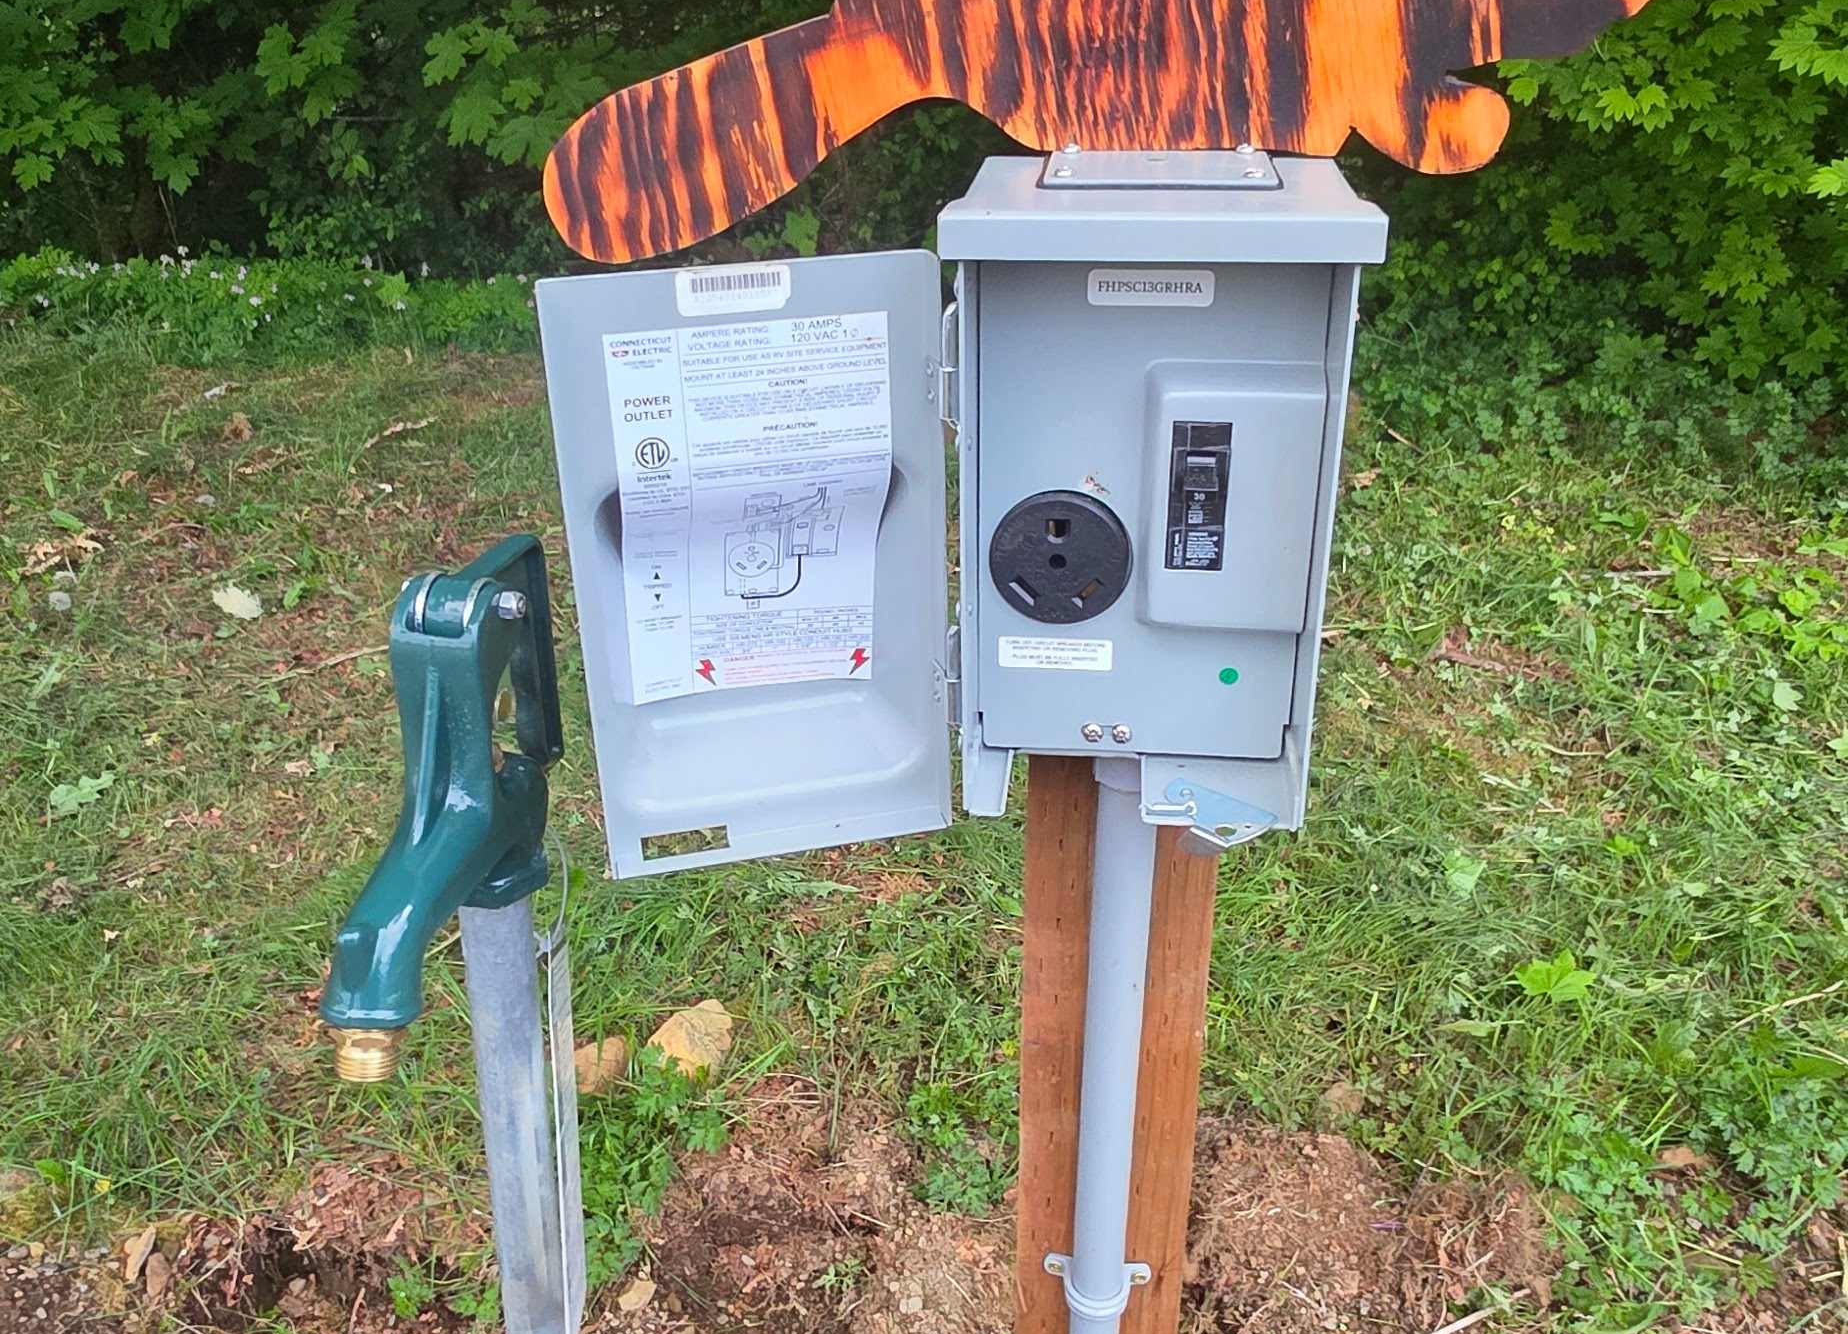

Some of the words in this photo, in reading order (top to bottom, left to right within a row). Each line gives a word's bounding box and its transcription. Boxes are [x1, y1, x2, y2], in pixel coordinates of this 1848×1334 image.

[791, 321, 805, 332] 30
[807, 318, 842, 330] AMPS
[609, 336, 672, 349] CONNECTICUT
[791, 332, 811, 343] 120
[812, 329, 839, 341] VAC
[632, 347, 673, 357] ELECTRIC
[624, 395, 671, 408] POWER
[624, 409, 673, 423] OUTLET
[636, 473, 673, 484] Intertek
